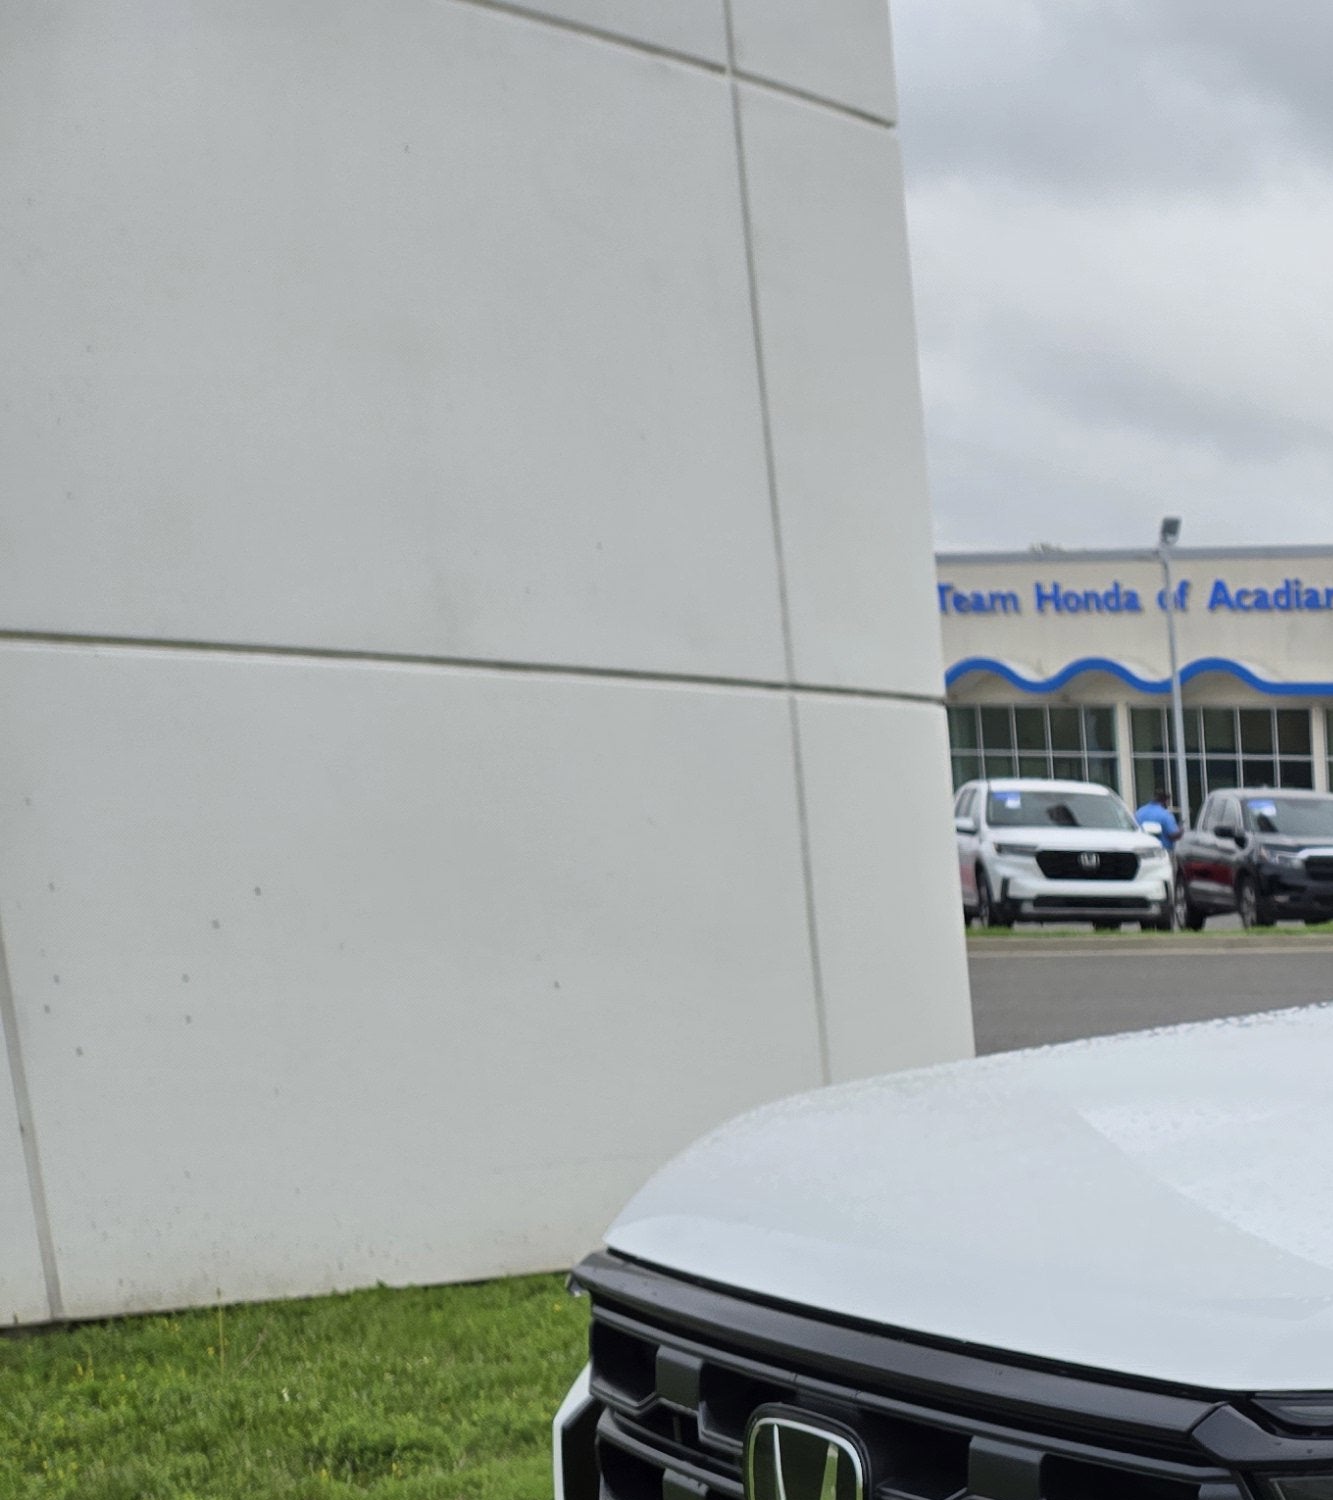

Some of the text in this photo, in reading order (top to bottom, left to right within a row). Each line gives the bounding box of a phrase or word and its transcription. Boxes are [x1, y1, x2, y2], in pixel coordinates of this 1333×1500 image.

[938, 583, 1020, 614] Team
[1034, 581, 1143, 613] Honda
[1157, 580, 1191, 612] of
